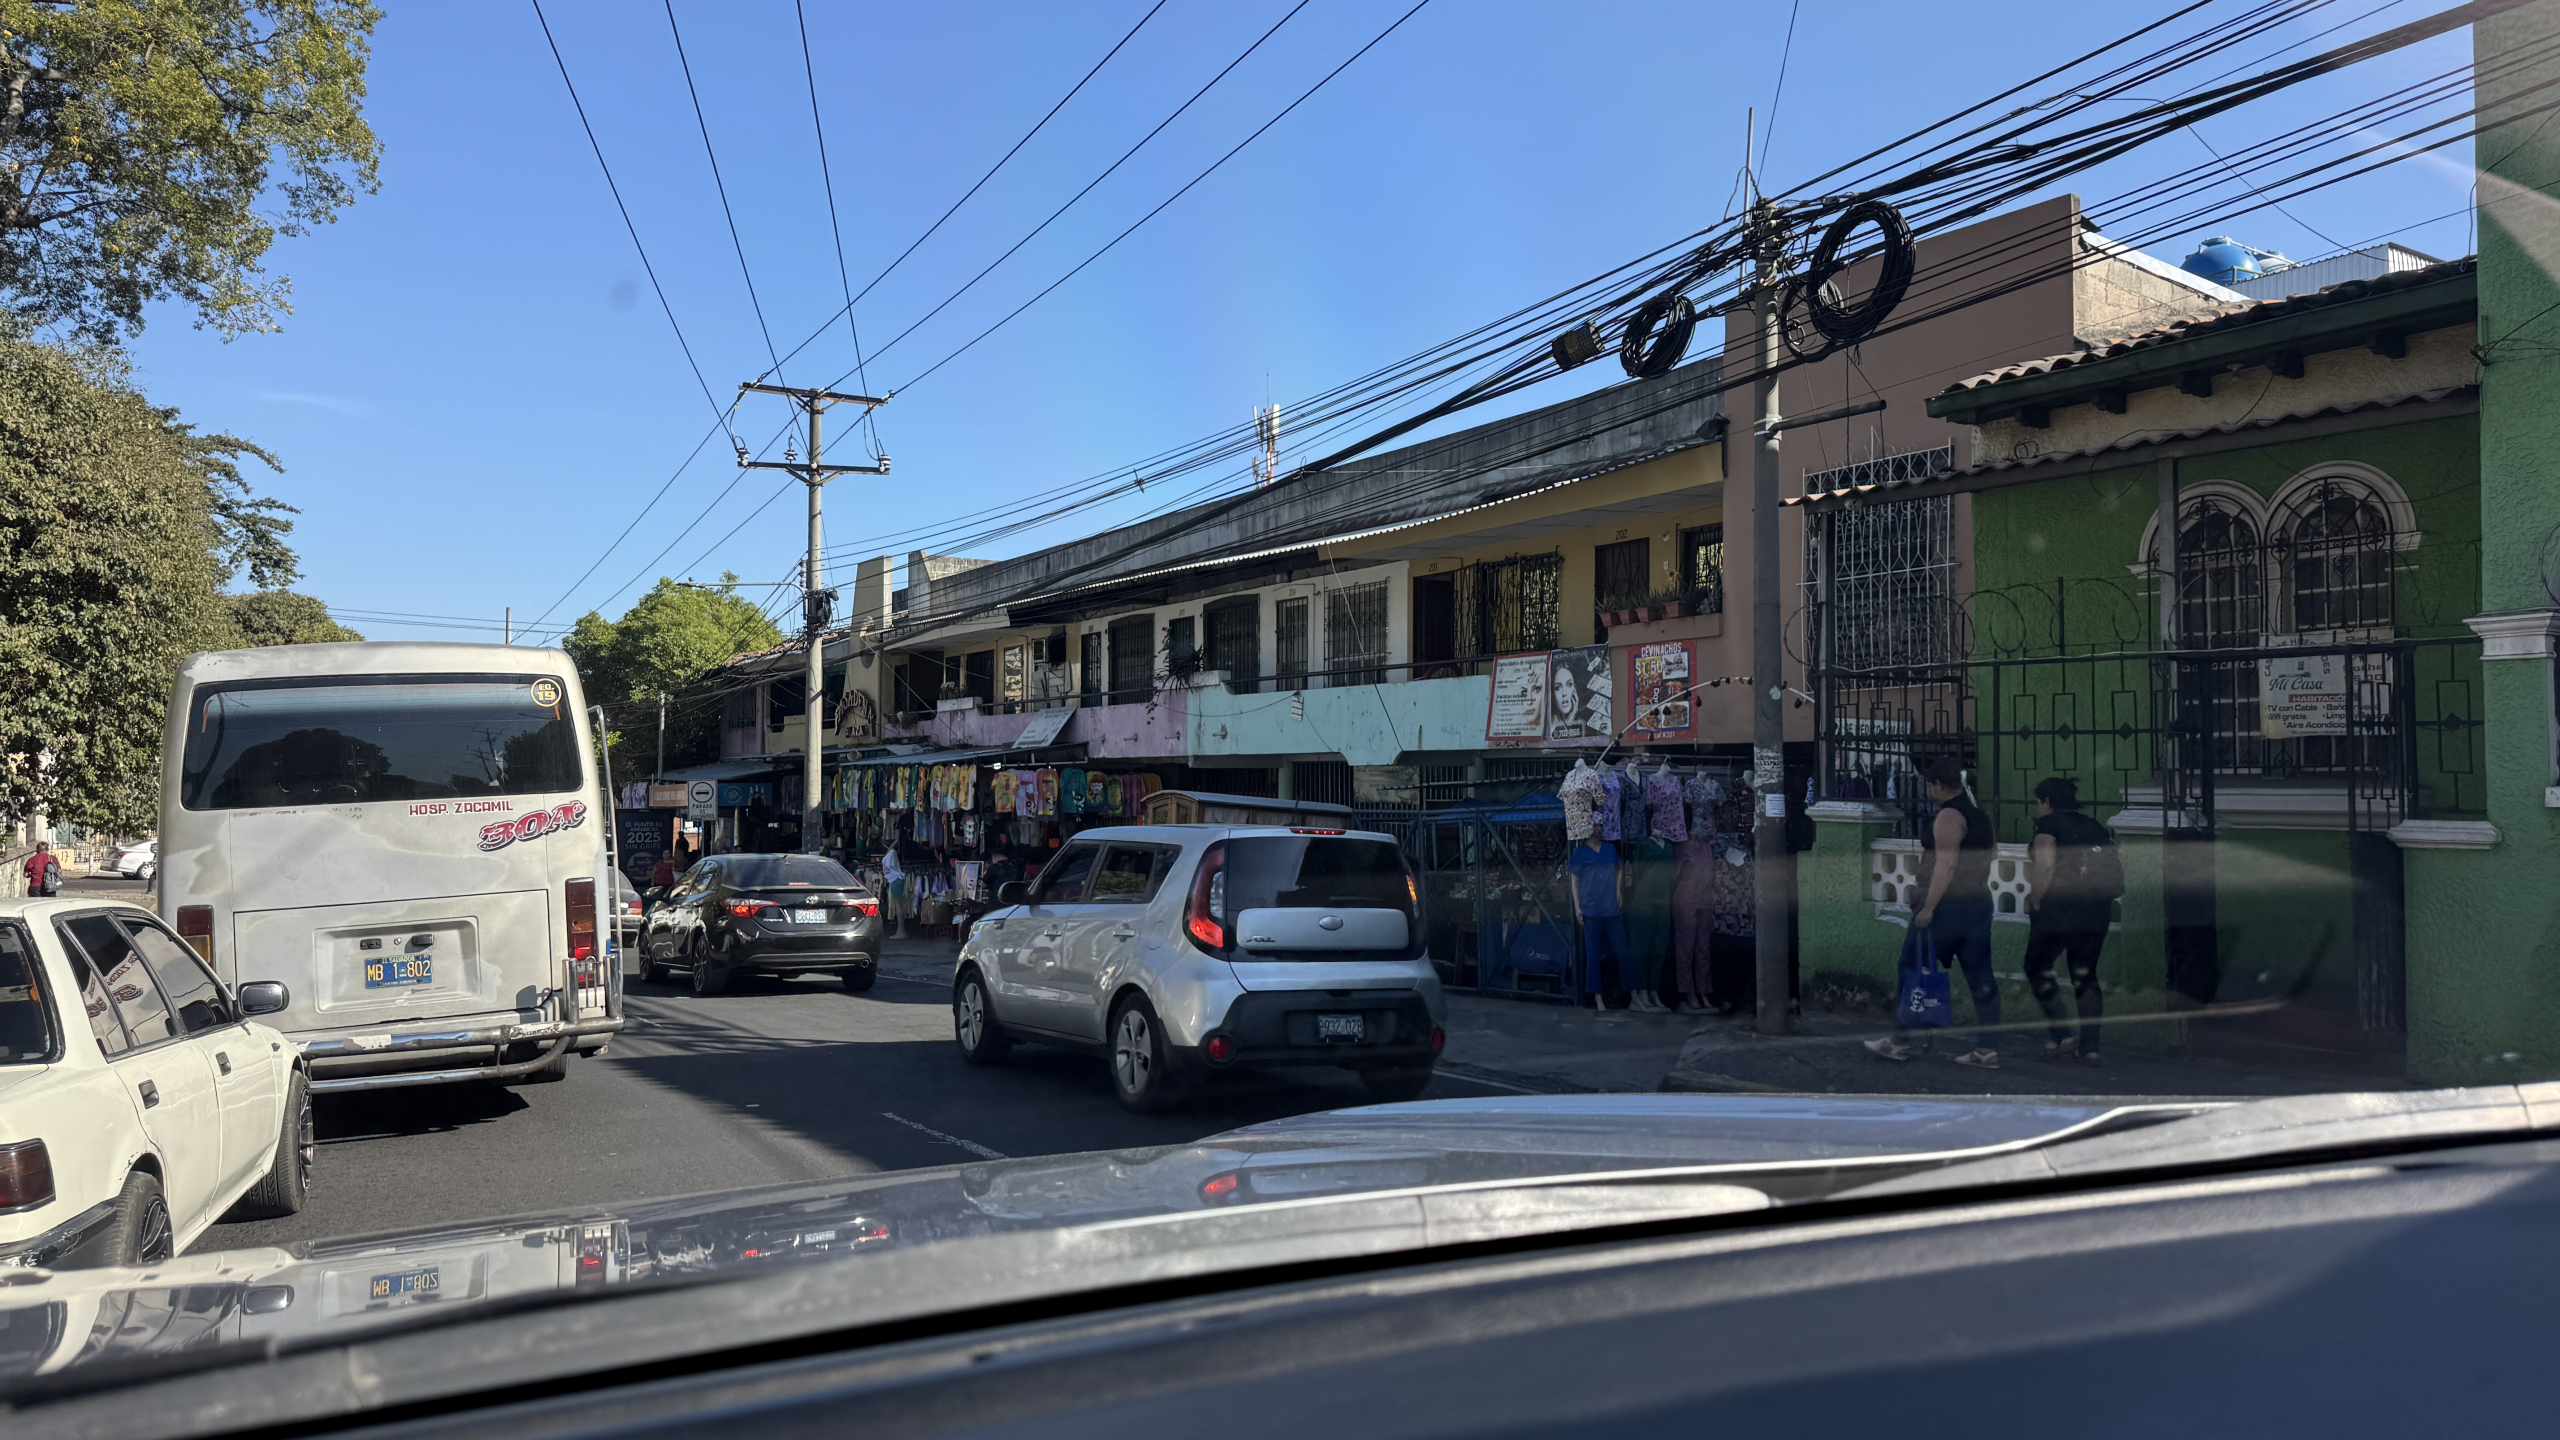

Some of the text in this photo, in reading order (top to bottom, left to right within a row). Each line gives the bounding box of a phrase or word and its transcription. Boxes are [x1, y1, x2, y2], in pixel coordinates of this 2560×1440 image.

[1615, 529, 1628, 540] 202
[1641, 642, 1682, 657] CEVINACHOS
[1635, 660, 1662, 676] $1.50
[2269, 677, 2325, 691] Mi Casa
[537, 690, 556, 701] 19
[2282, 713, 2307, 721] gratis
[2286, 721, 2304, 729] Aire
[409, 800, 513, 816] HOSP. ZACAMIL
[627, 832, 662, 844] 2025
[367, 964, 384, 982] MB
